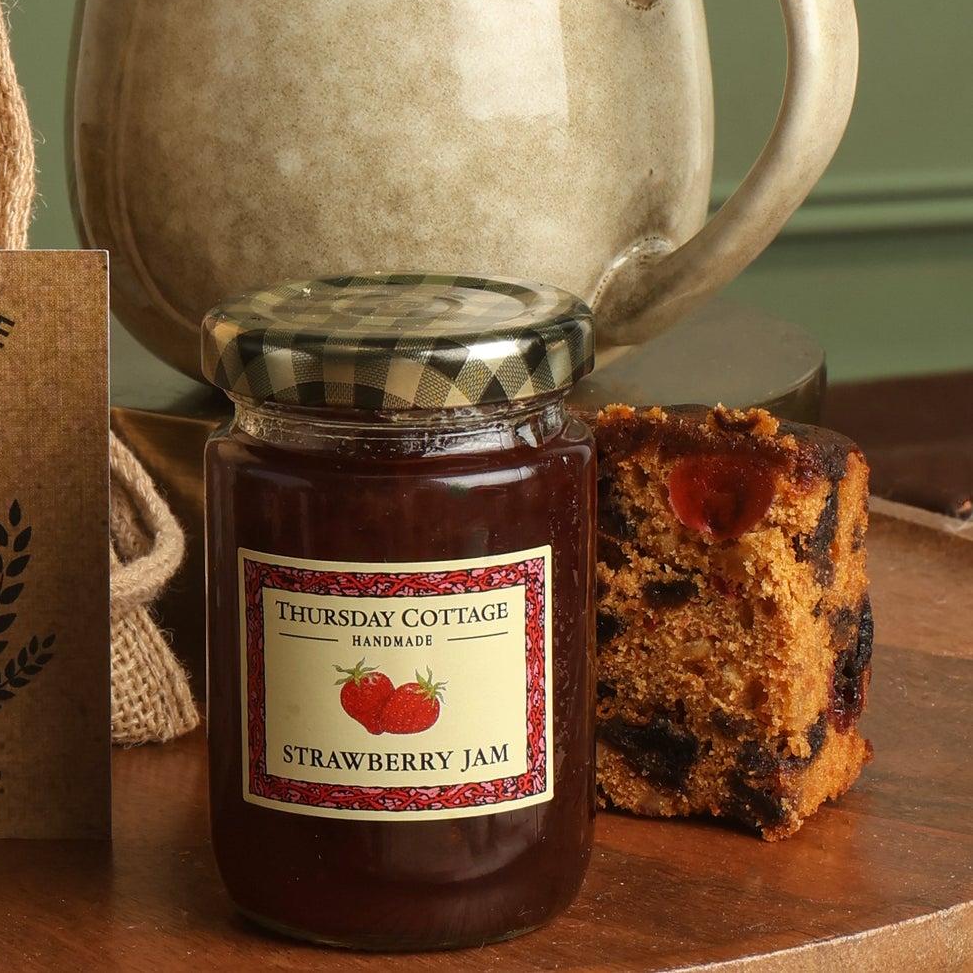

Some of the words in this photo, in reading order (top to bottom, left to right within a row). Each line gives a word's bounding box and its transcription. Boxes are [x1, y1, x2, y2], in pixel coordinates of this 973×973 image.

[275, 599, 395, 628] THURSDAY
[401, 601, 509, 628] COTTAGE
[352, 634, 433, 648] HANDMADE
[283, 744, 454, 772] STRAWBERRY
[460, 743, 510, 773] JAM
